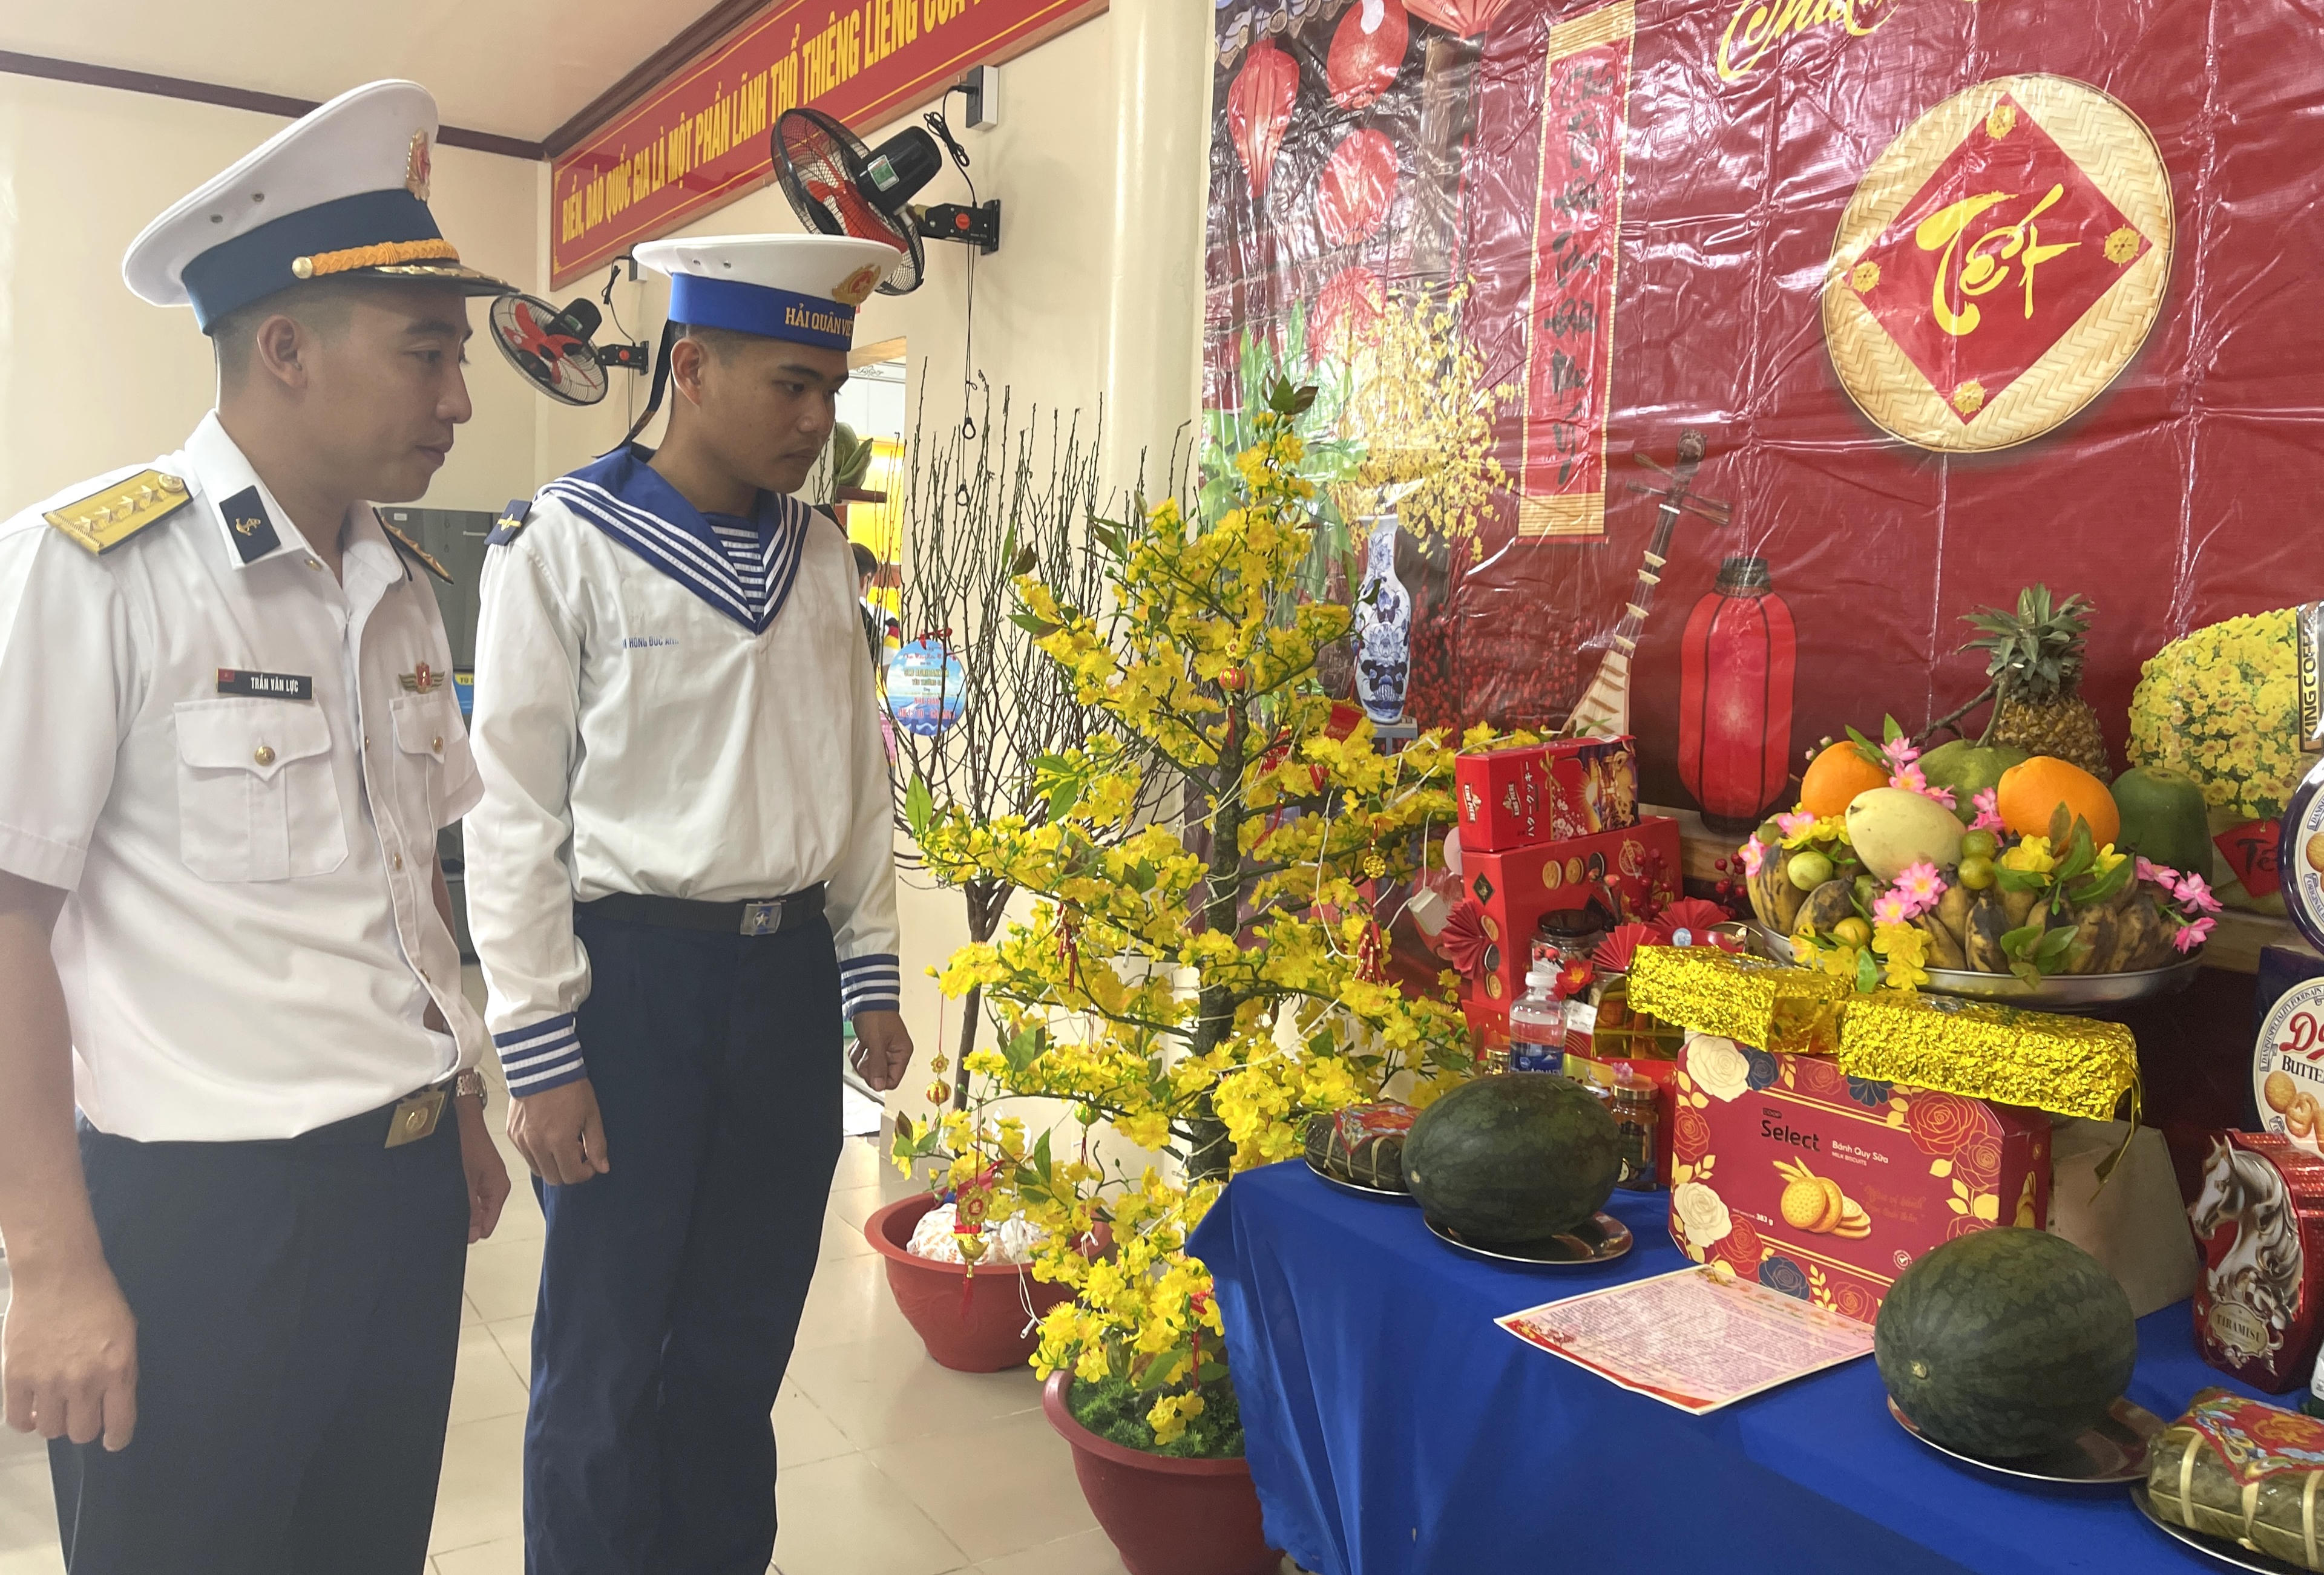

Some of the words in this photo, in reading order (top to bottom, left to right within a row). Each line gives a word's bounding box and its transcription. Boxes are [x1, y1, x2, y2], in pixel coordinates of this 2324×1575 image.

[606, 143, 632, 224] QUỐC
[632, 146, 650, 204] GIA
[652, 125, 665, 193] LÀ
[668, 111, 693, 189] MỘT
[694, 80, 730, 169] PHẦN
[732, 71, 767, 148] LÃNH
[770, 23, 800, 125] THỔ
[802, 9, 861, 106] THIÊNG
[1915, 183, 2082, 336] Tết
[785, 302, 810, 329] HẢI
[811, 310, 842, 335] QUÂN
[251, 673, 269, 690] TRẦN
[271, 676, 284, 692] VĂN
[286, 679, 299, 695] LỰC
[2303, 690, 2318, 742] KING
[2261, 1036, 2272, 1064] DANISH
[1761, 1119, 1820, 1152] Select
[1832, 1140, 1853, 1154] Bánh
[1854, 1146, 1871, 1161] Quy
[1873, 1151, 1889, 1164] Sữa
[1832, 1151, 1845, 1160] MILK
[1845, 1154, 1867, 1167] BISCUITS
